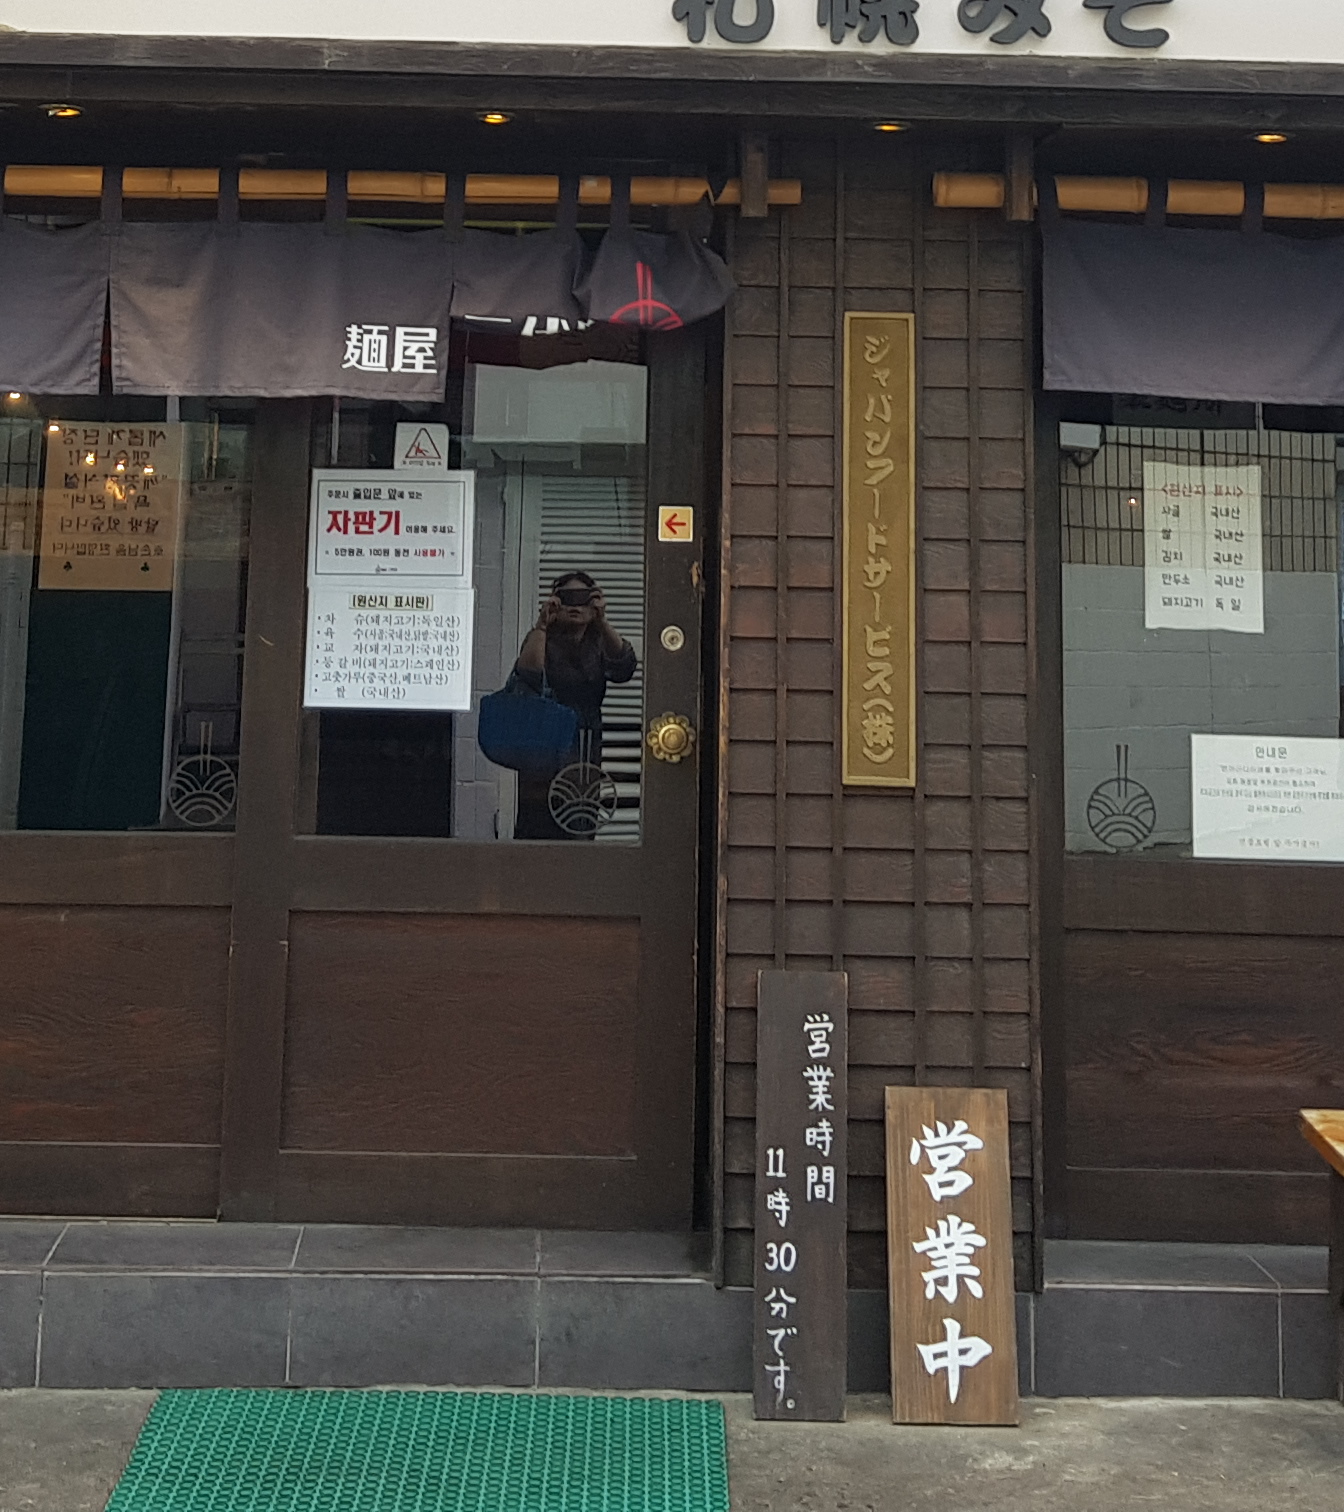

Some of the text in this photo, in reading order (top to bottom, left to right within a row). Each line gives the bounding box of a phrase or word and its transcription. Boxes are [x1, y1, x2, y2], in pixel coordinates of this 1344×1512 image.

[342, 323, 438, 374] 麺屋
[1210, 505, 1241, 520] 국내산
[326, 510, 401, 536] 자판기
[1214, 528, 1244, 543] 국내산
[1213, 551, 1244, 565] 국내산
[1214, 574, 1245, 588] 국내산
[1255, 745, 1288, 759] 안내문
[802, 1013, 835, 1205] 営業時間
[909, 1119, 993, 1405] 営業中
